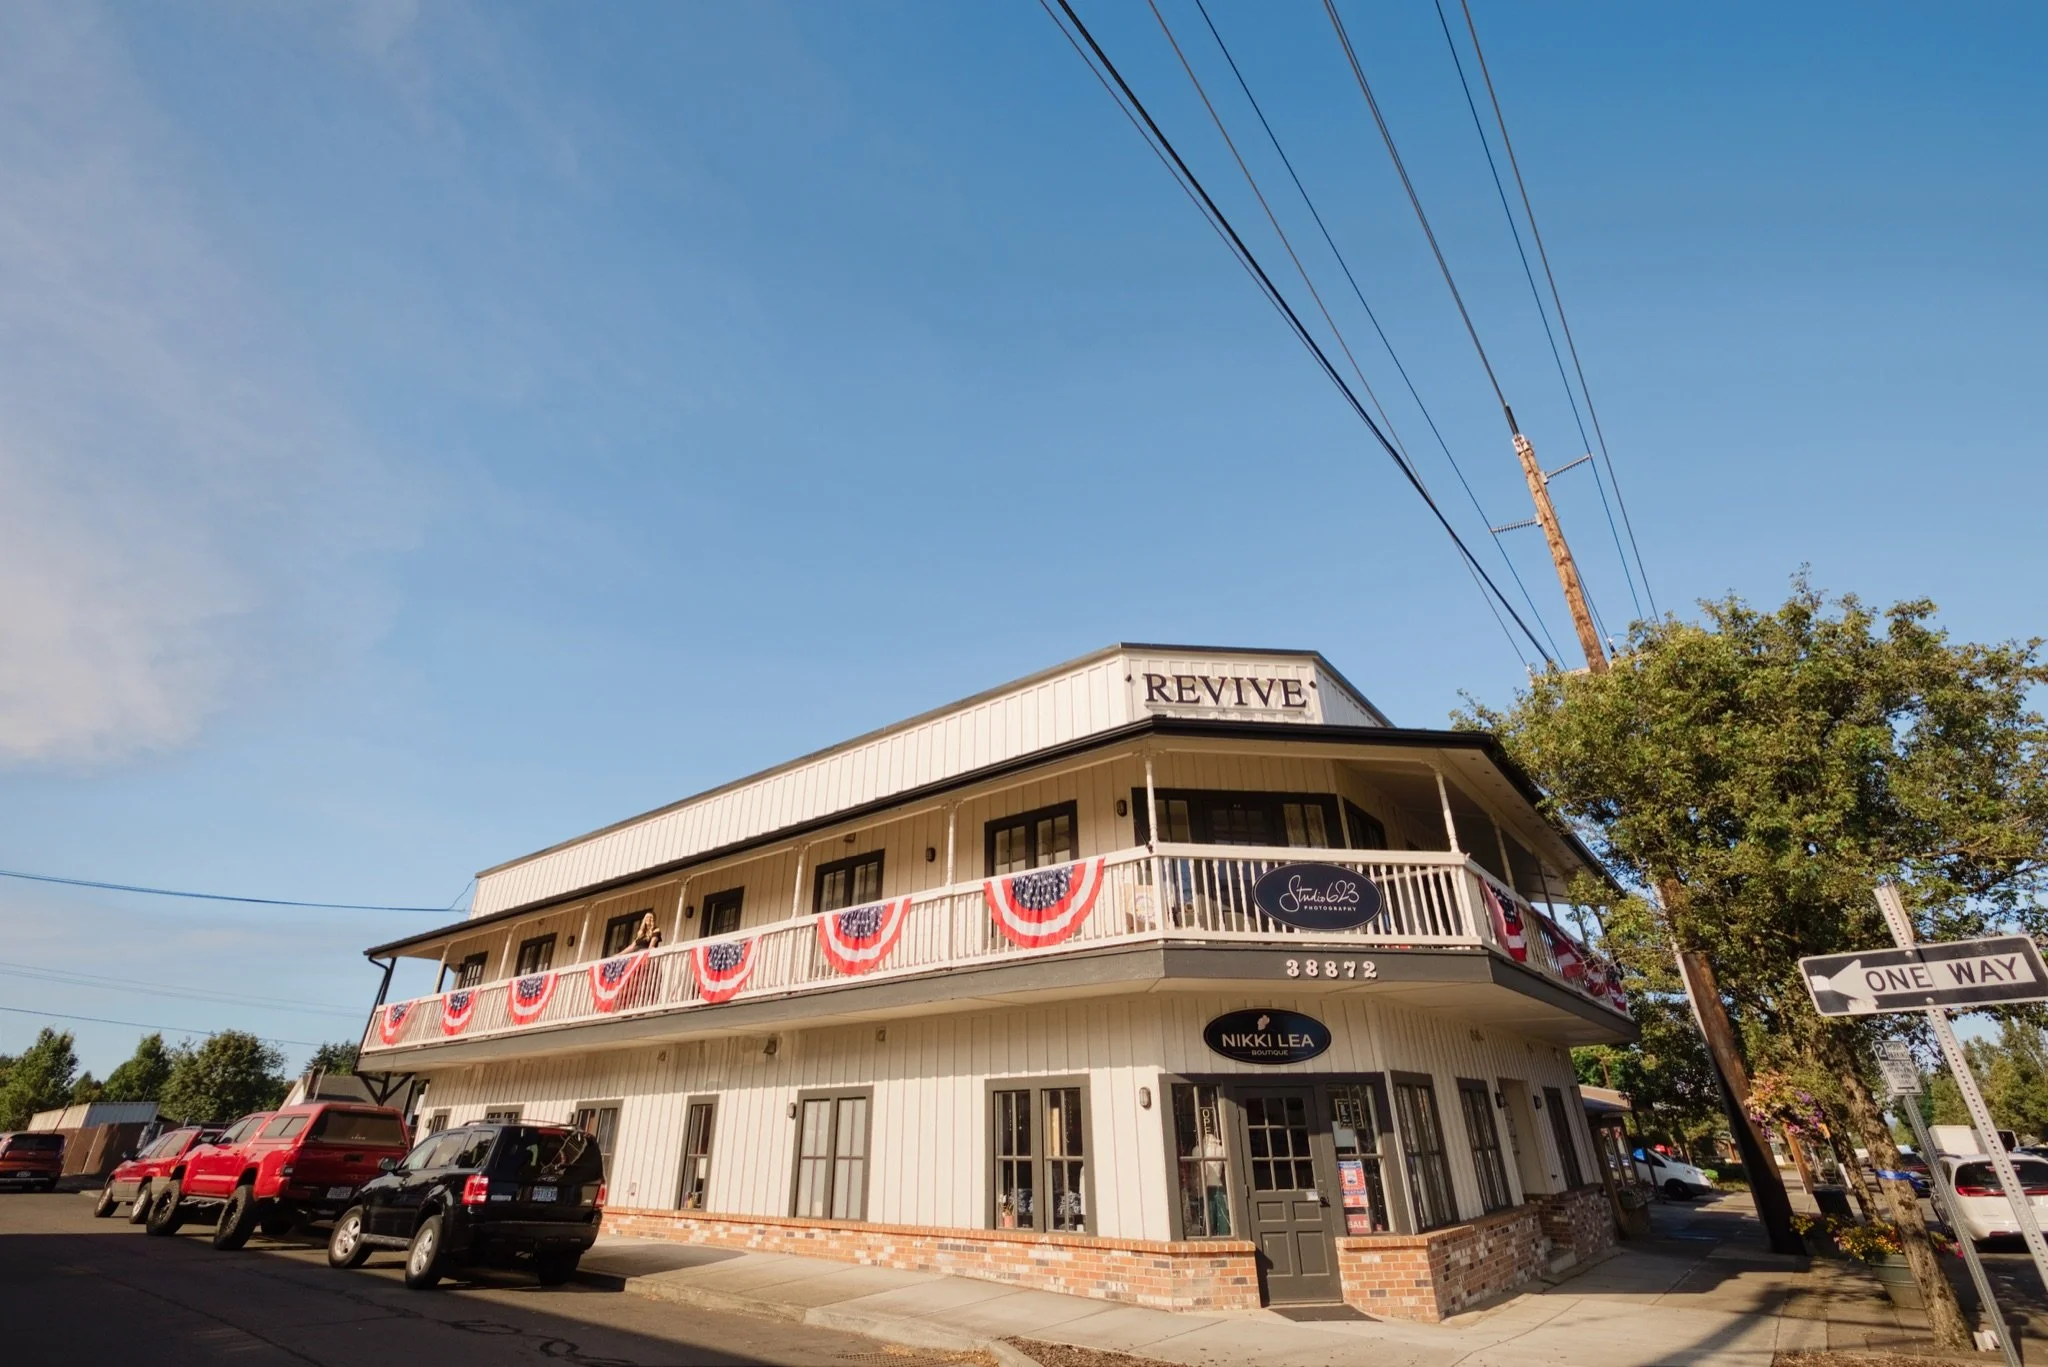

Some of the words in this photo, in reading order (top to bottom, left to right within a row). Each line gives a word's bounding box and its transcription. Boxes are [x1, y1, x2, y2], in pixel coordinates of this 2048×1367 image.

[1142, 672, 1308, 708] REVIVE
[1286, 959, 1377, 979] 38872
[1865, 966, 1934, 992] ONE
[1946, 956, 2018, 986] WAY
[1222, 1034, 1272, 1048] NIKKI
[1278, 1034, 1315, 1048] LEA
[1875, 1043, 1887, 1058] 2
[1203, 1109, 1211, 1141] OPE
[1347, 1220, 1369, 1229] SALE
